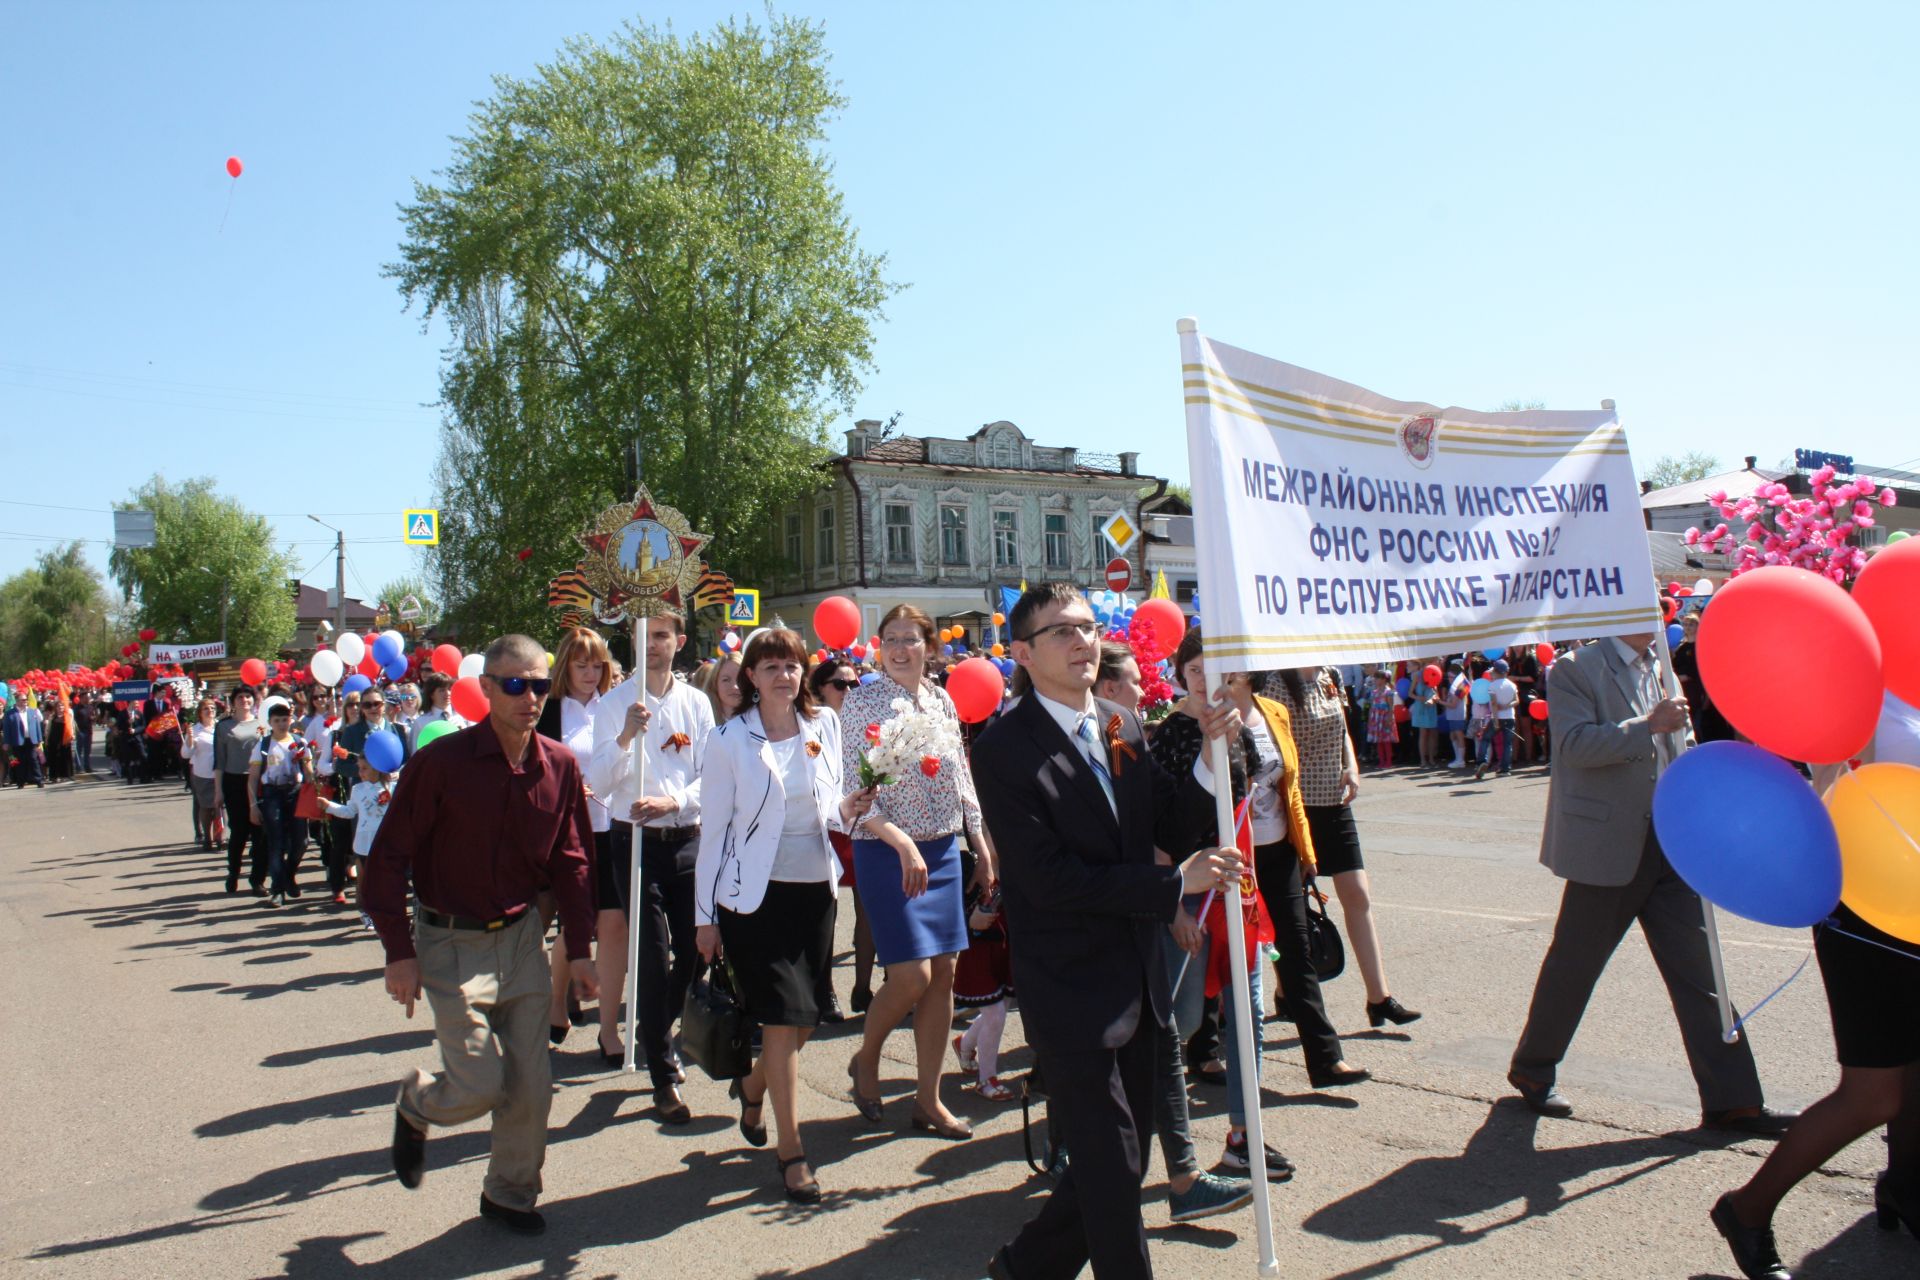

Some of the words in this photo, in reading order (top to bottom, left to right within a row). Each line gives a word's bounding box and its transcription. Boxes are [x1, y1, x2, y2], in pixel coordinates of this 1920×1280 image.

[1241, 457, 1447, 516] МЕЖРАЙОННАЯ
[1454, 483, 1609, 519] ИНСПЕКЦИЯ
[1309, 522, 1370, 562] ФНС
[1378, 528, 1500, 564] РОССИИ
[1505, 525, 1561, 558] №12
[626, 582, 666, 595] ПОБЕДА
[1254, 574, 1288, 616] ПО
[1296, 575, 1488, 616] РЕСПУБЛИКЕ
[1493, 566, 1624, 605] ТАТАРСТАН
[155, 651, 172, 662] НА
[179, 643, 225, 661] БЕРЛИН!
